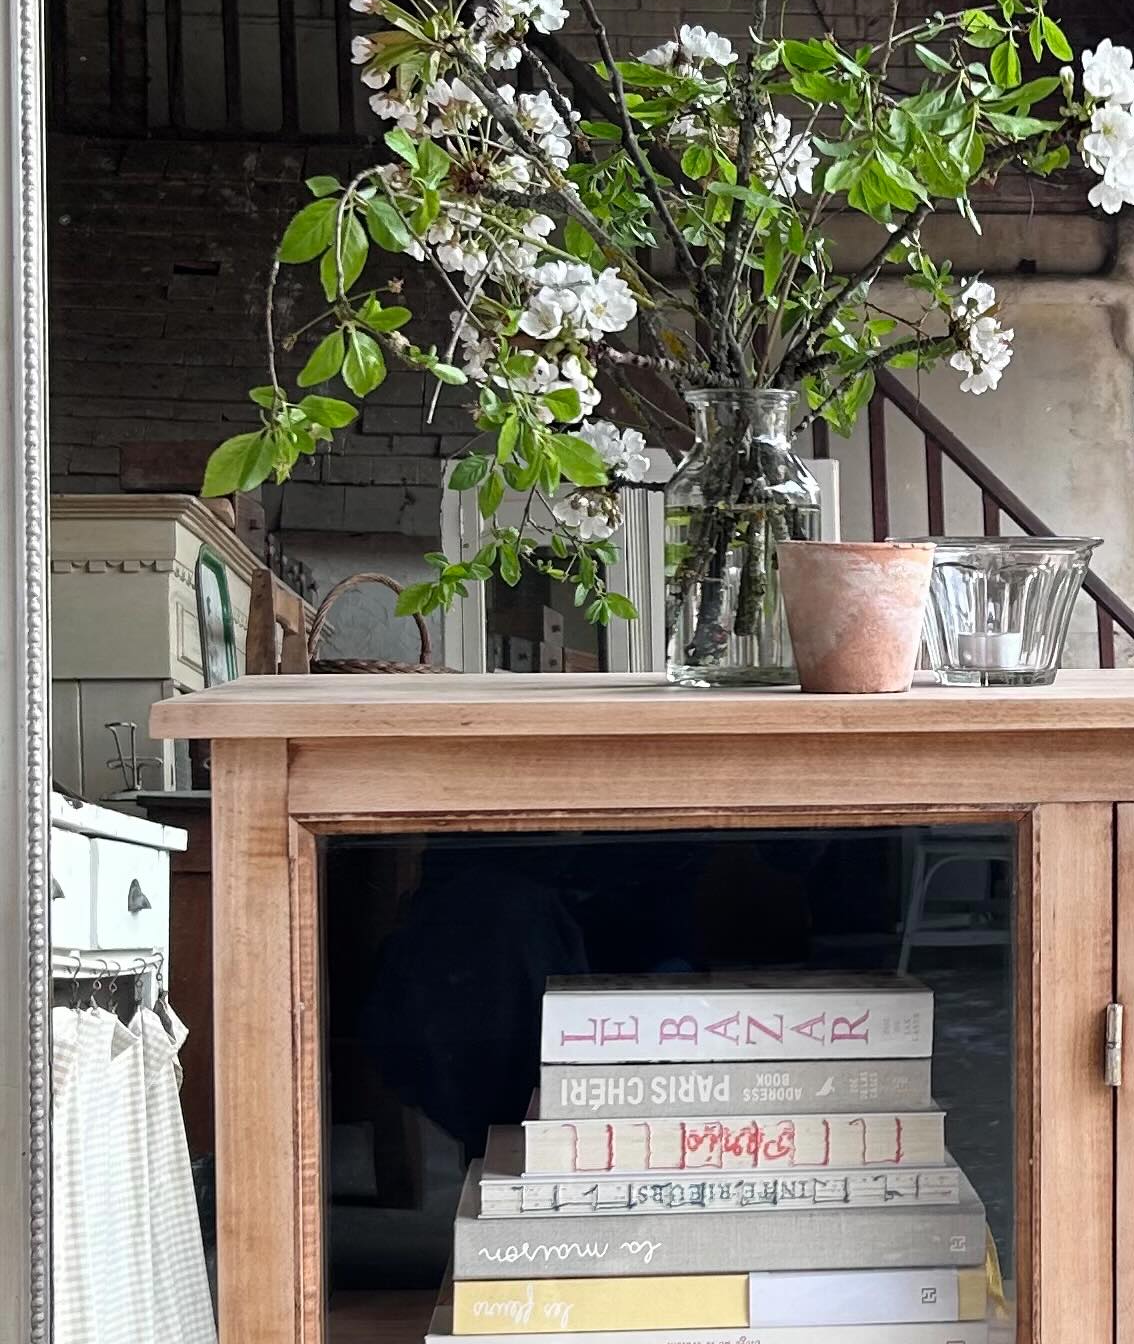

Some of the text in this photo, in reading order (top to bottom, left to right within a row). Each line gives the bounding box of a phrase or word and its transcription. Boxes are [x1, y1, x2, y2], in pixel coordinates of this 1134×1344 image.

[560, 1015, 639, 1046] LE
[659, 1009, 869, 1045] BAZAR
[560, 1073, 730, 1110] PARIS CHÉRI
[743, 1086, 802, 1105] ADDRESS
[755, 1072, 790, 1087] BOOK
[687, 1125, 795, 1162] Paris
[478, 1240, 662, 1269] la maison
[473, 1281, 574, 1329] les fleurs
